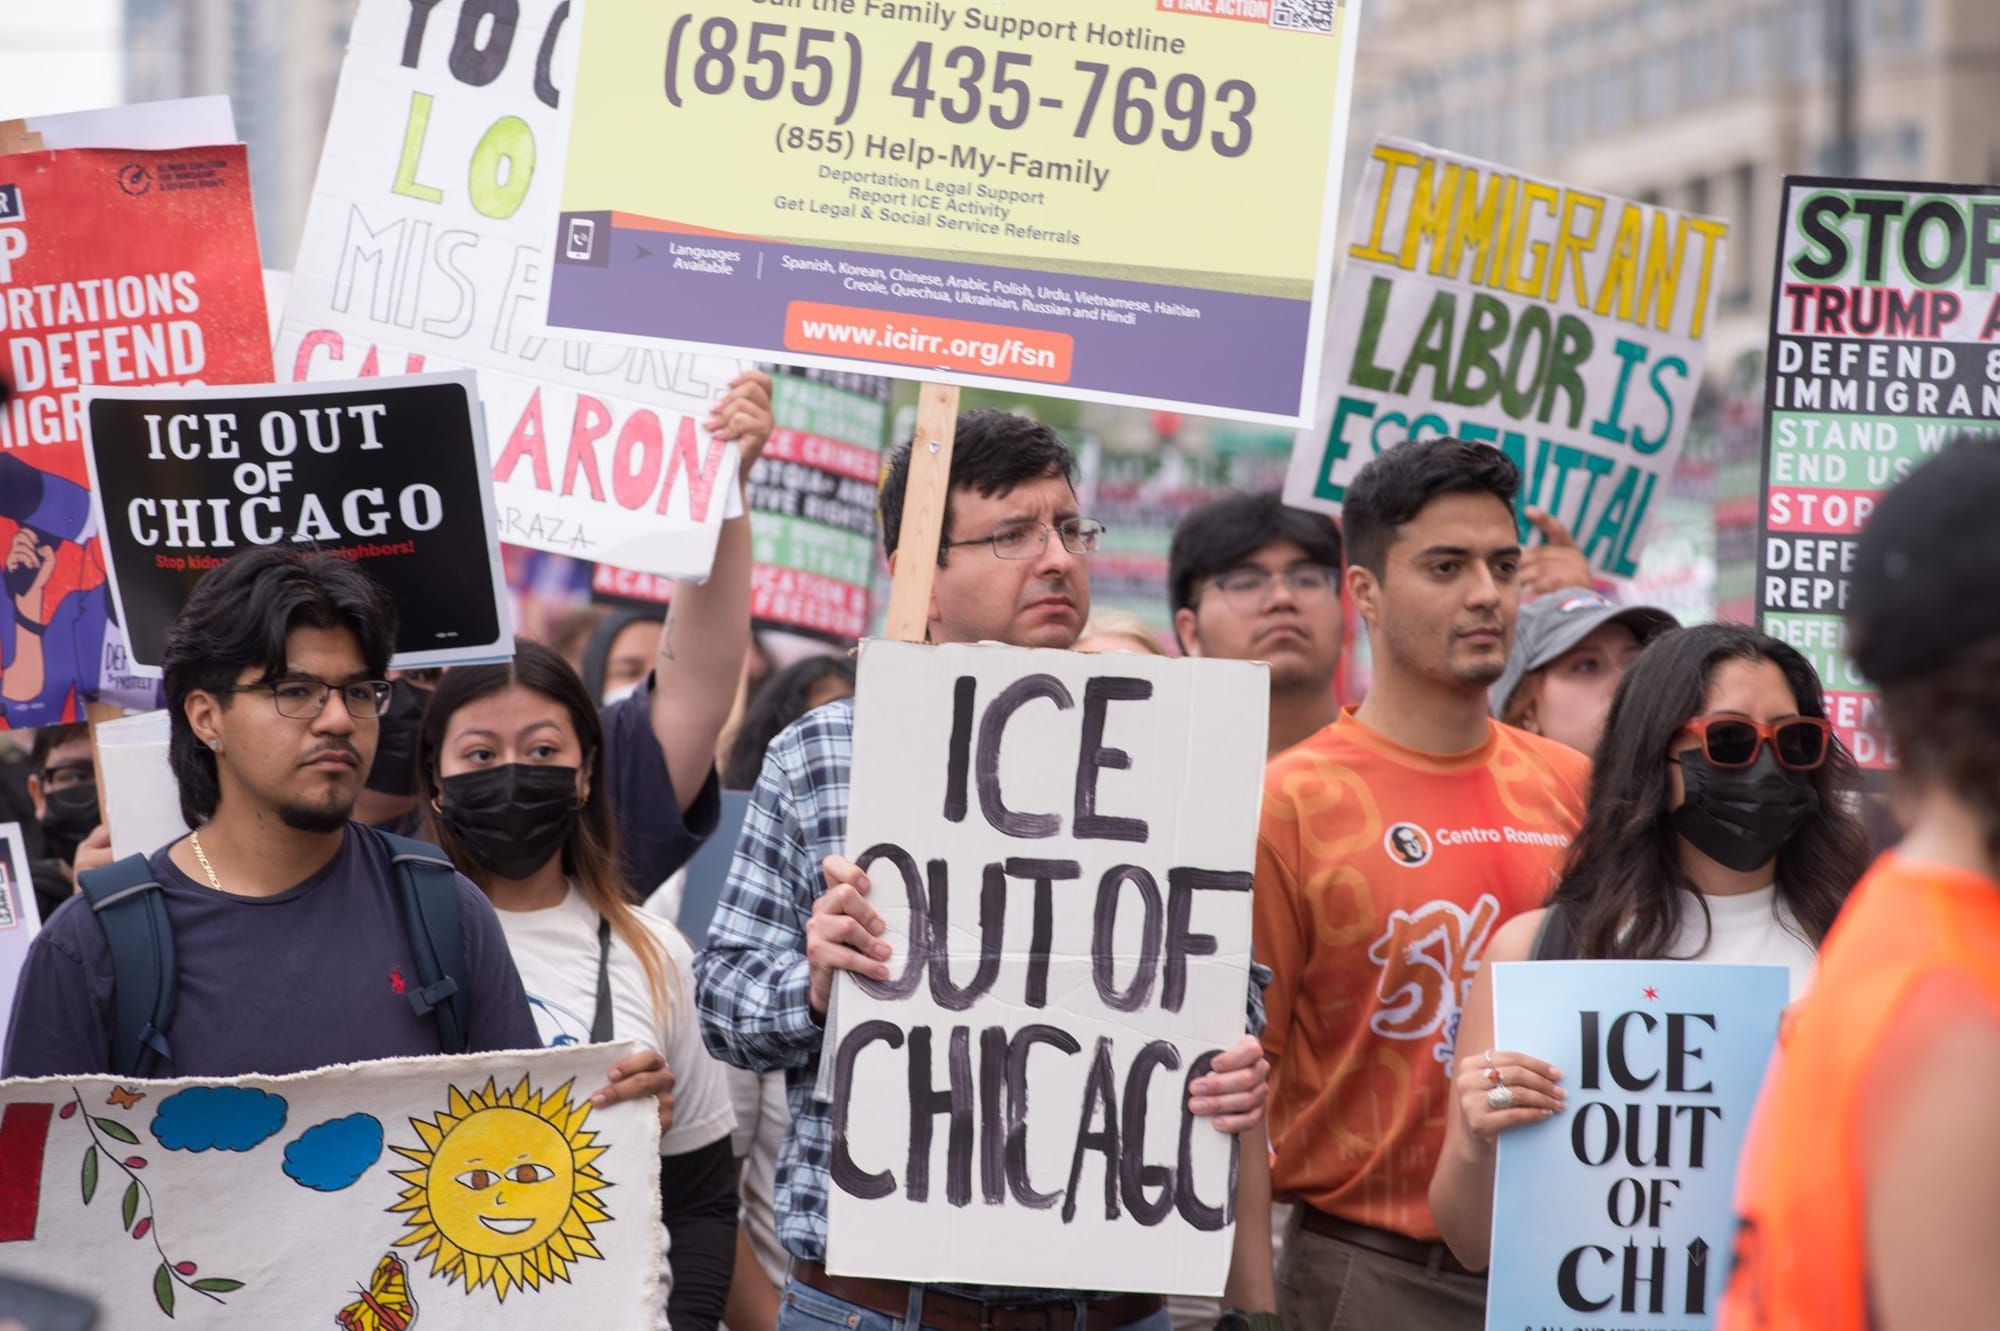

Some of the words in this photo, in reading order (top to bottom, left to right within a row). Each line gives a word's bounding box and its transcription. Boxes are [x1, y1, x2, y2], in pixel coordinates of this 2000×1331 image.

[865, 0, 956, 31] Family
[964, 8, 1077, 41] Support
[1087, 22, 1186, 54] Hotline
[665, 13, 862, 125] (855)
[891, 41, 1257, 157] 435-7693
[776, 123, 854, 160] (855)
[865, 134, 1110, 191] Help-My-Family
[818, 165, 920, 190] Deportation
[925, 178, 971, 197] Legal
[977, 184, 1044, 206] Support
[849, 187, 906, 208] Report
[912, 194, 940, 210] ICE
[946, 197, 1010, 221] Activity
[774, 195, 804, 211] Get
[810, 199, 855, 219] Legal
[861, 206, 874, 220] &
[880, 208, 931, 227] Social
[937, 214, 999, 236] Service
[1005, 221, 1081, 245] Referrals
[1349, 145, 1728, 339] IMMIGRANT
[331, 203, 479, 340] MIS
[669, 241, 742, 262] Languages
[673, 257, 734, 276] Available
[0, 271, 199, 332] RTATIONS
[781, 254, 836, 275] Spanish,
[839, 262, 887, 281] Korean,
[889, 268, 944, 287] Chinese,
[946, 275, 990, 293] Arabic,
[993, 280, 1035, 298] Polish,
[1037, 286, 1072, 303] Urdu,
[1074, 290, 1152, 313] Vietnamese,
[1155, 301, 1201, 319] Haitian
[843, 276, 888, 295] Creole,
[891, 283, 951, 304] Quechua,
[955, 291, 1019, 312] Ukrainian,
[1022, 298, 1071, 317] Russian
[1073, 308, 1099, 321] and
[1100, 309, 1137, 325] Hindi
[1784, 283, 1961, 341] TRUMP
[9, 320, 205, 392] DEFEND
[802, 320, 1056, 369] www.icirr.org/fsn
[1348, 275, 1593, 429] LABOR
[1591, 337, 1688, 455] IS
[1778, 340, 1956, 380] DEFEND
[144, 413, 241, 461] ICE
[259, 404, 387, 457] OUT
[1776, 418, 1898, 452] STAND
[233, 460, 293, 495] OF
[1774, 452, 1846, 482] END
[127, 483, 444, 548] CHICAGO
[1769, 493, 1874, 527] STOP
[155, 554, 185, 572] Stop
[943, 672, 1153, 843] ICE
[1435, 826, 1500, 845] Centro
[1503, 826, 1568, 848] Romero
[849, 843, 1082, 1011] OUT
[1092, 864, 1253, 1013] OF
[1578, 1010, 1717, 1092] ICE
[1571, 1102, 1722, 1169] OUT
[1607, 1177, 1681, 1228] OF
[1557, 1235, 1710, 1315] CHI
